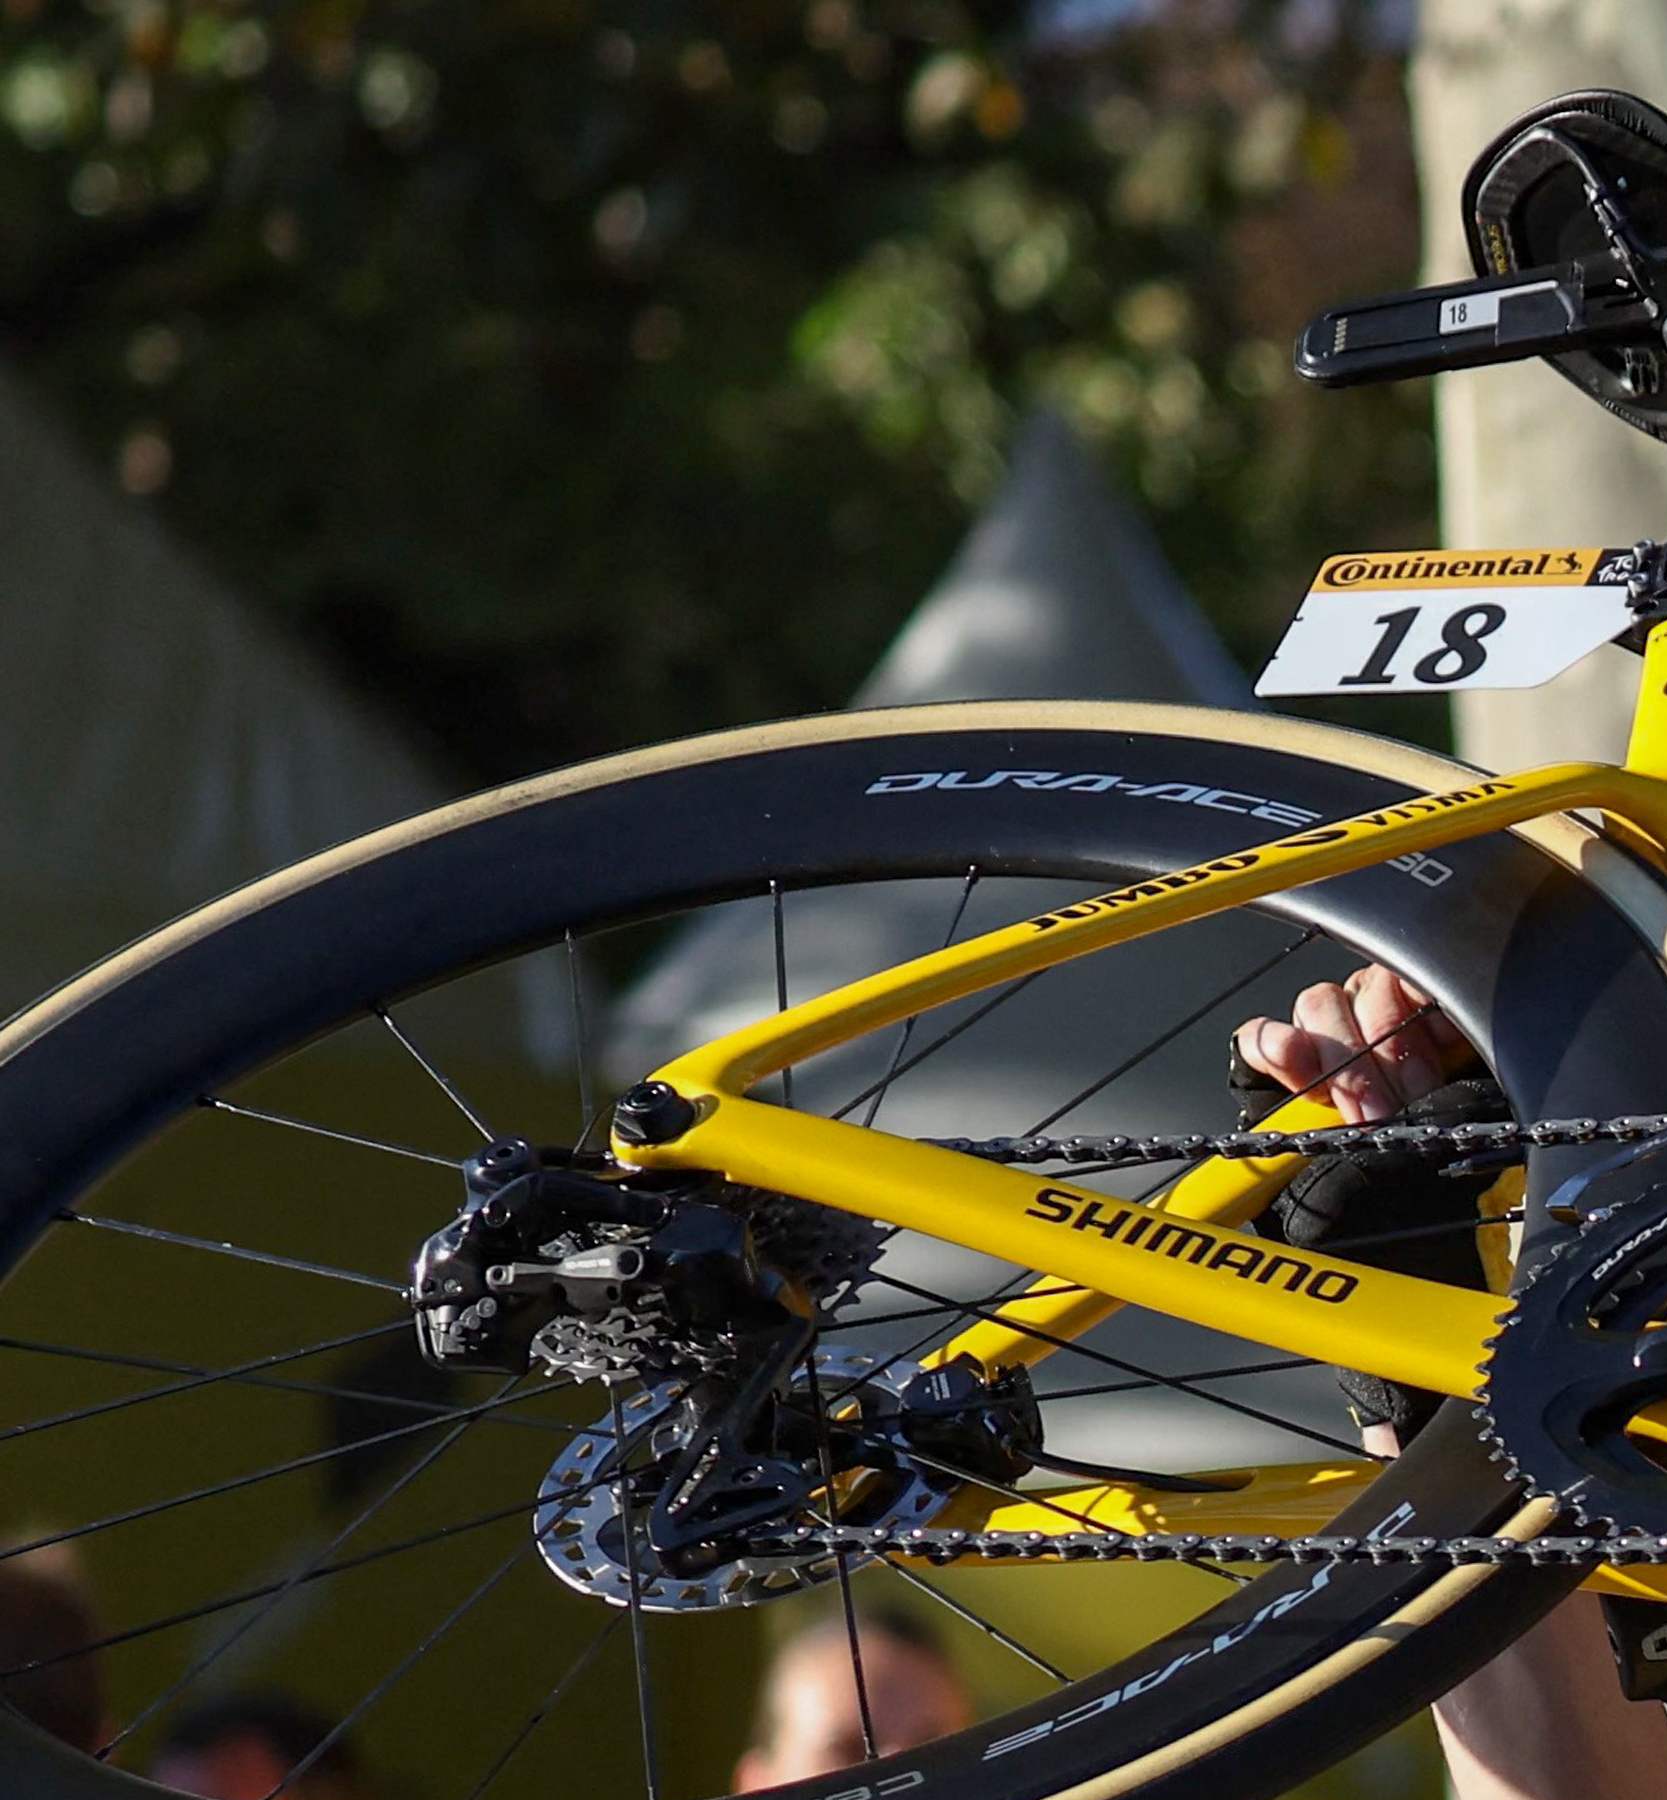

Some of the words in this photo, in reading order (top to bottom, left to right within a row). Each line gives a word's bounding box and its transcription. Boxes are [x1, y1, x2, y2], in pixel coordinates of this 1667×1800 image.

[1448, 302, 1467, 325] 18
[1322, 552, 1547, 587] Continental
[1336, 602, 1507, 686] 18
[865, 770, 1323, 828] DURA-ACE
[1363, 780, 1518, 828] VISMA
[1032, 852, 1261, 934] JUMBO
[1024, 1187, 1360, 1305] SHIMANO
